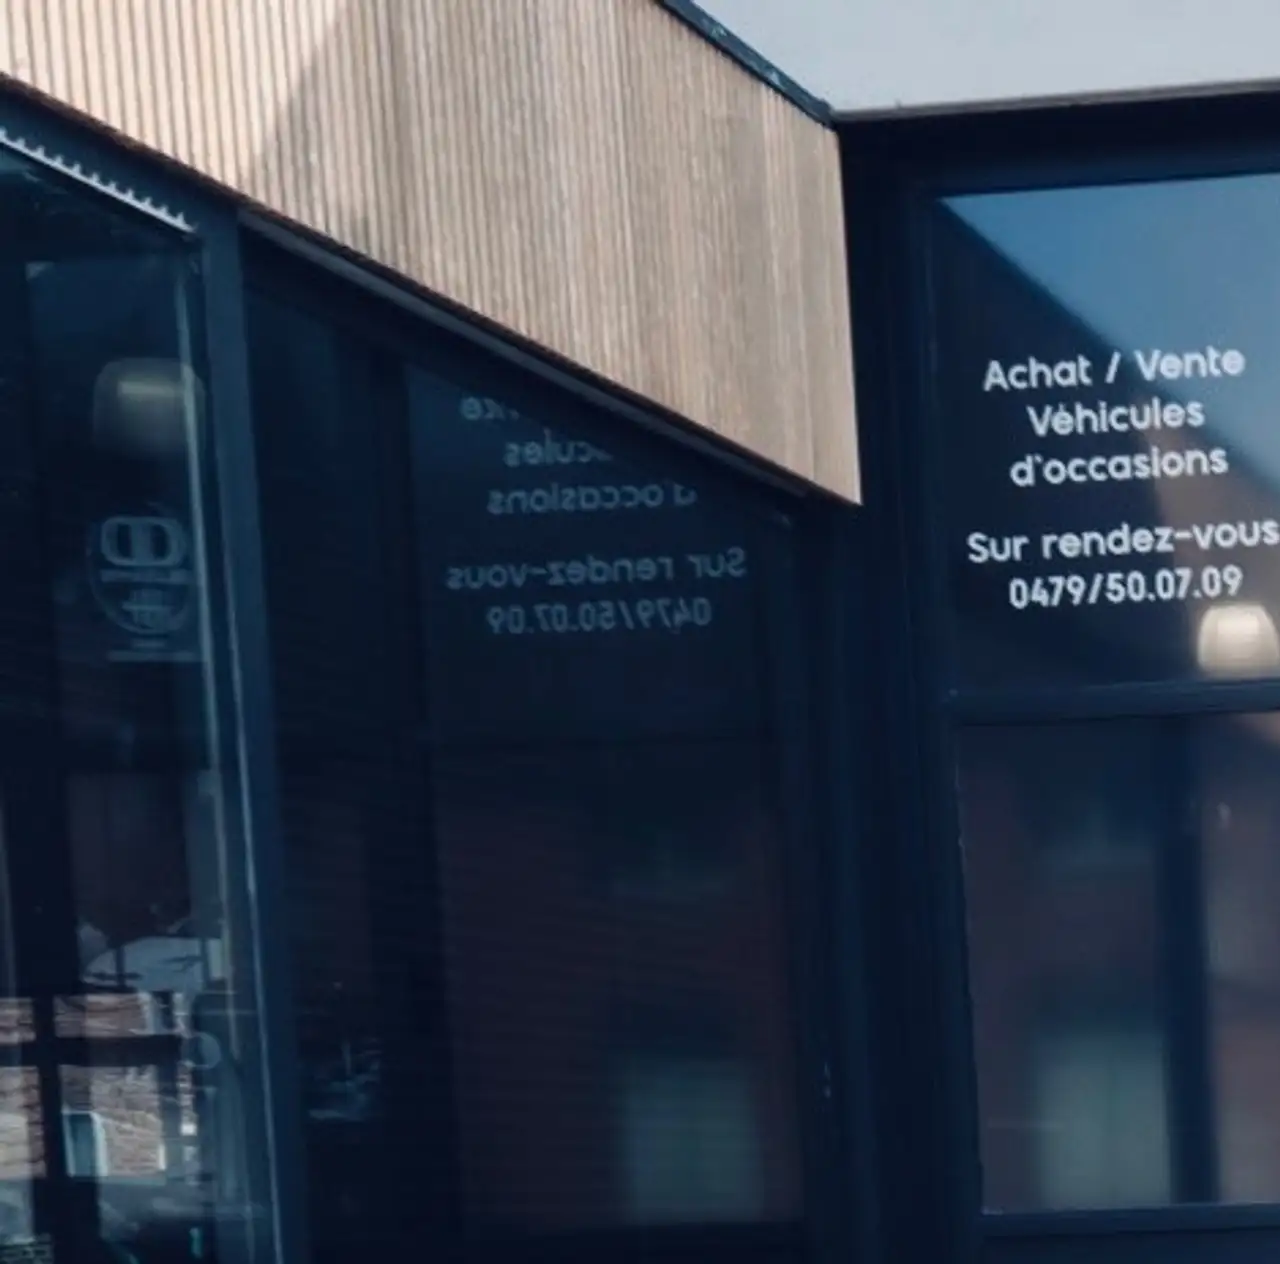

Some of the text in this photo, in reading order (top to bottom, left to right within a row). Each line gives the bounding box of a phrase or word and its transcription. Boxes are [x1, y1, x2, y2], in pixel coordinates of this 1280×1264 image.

[984, 346, 1245, 391] Achat / Vente
[1010, 447, 1227, 486] d'occasions
[967, 519, 1280, 564] Sur rendez-vous
[1009, 567, 1243, 608] 0479/50.07.09
